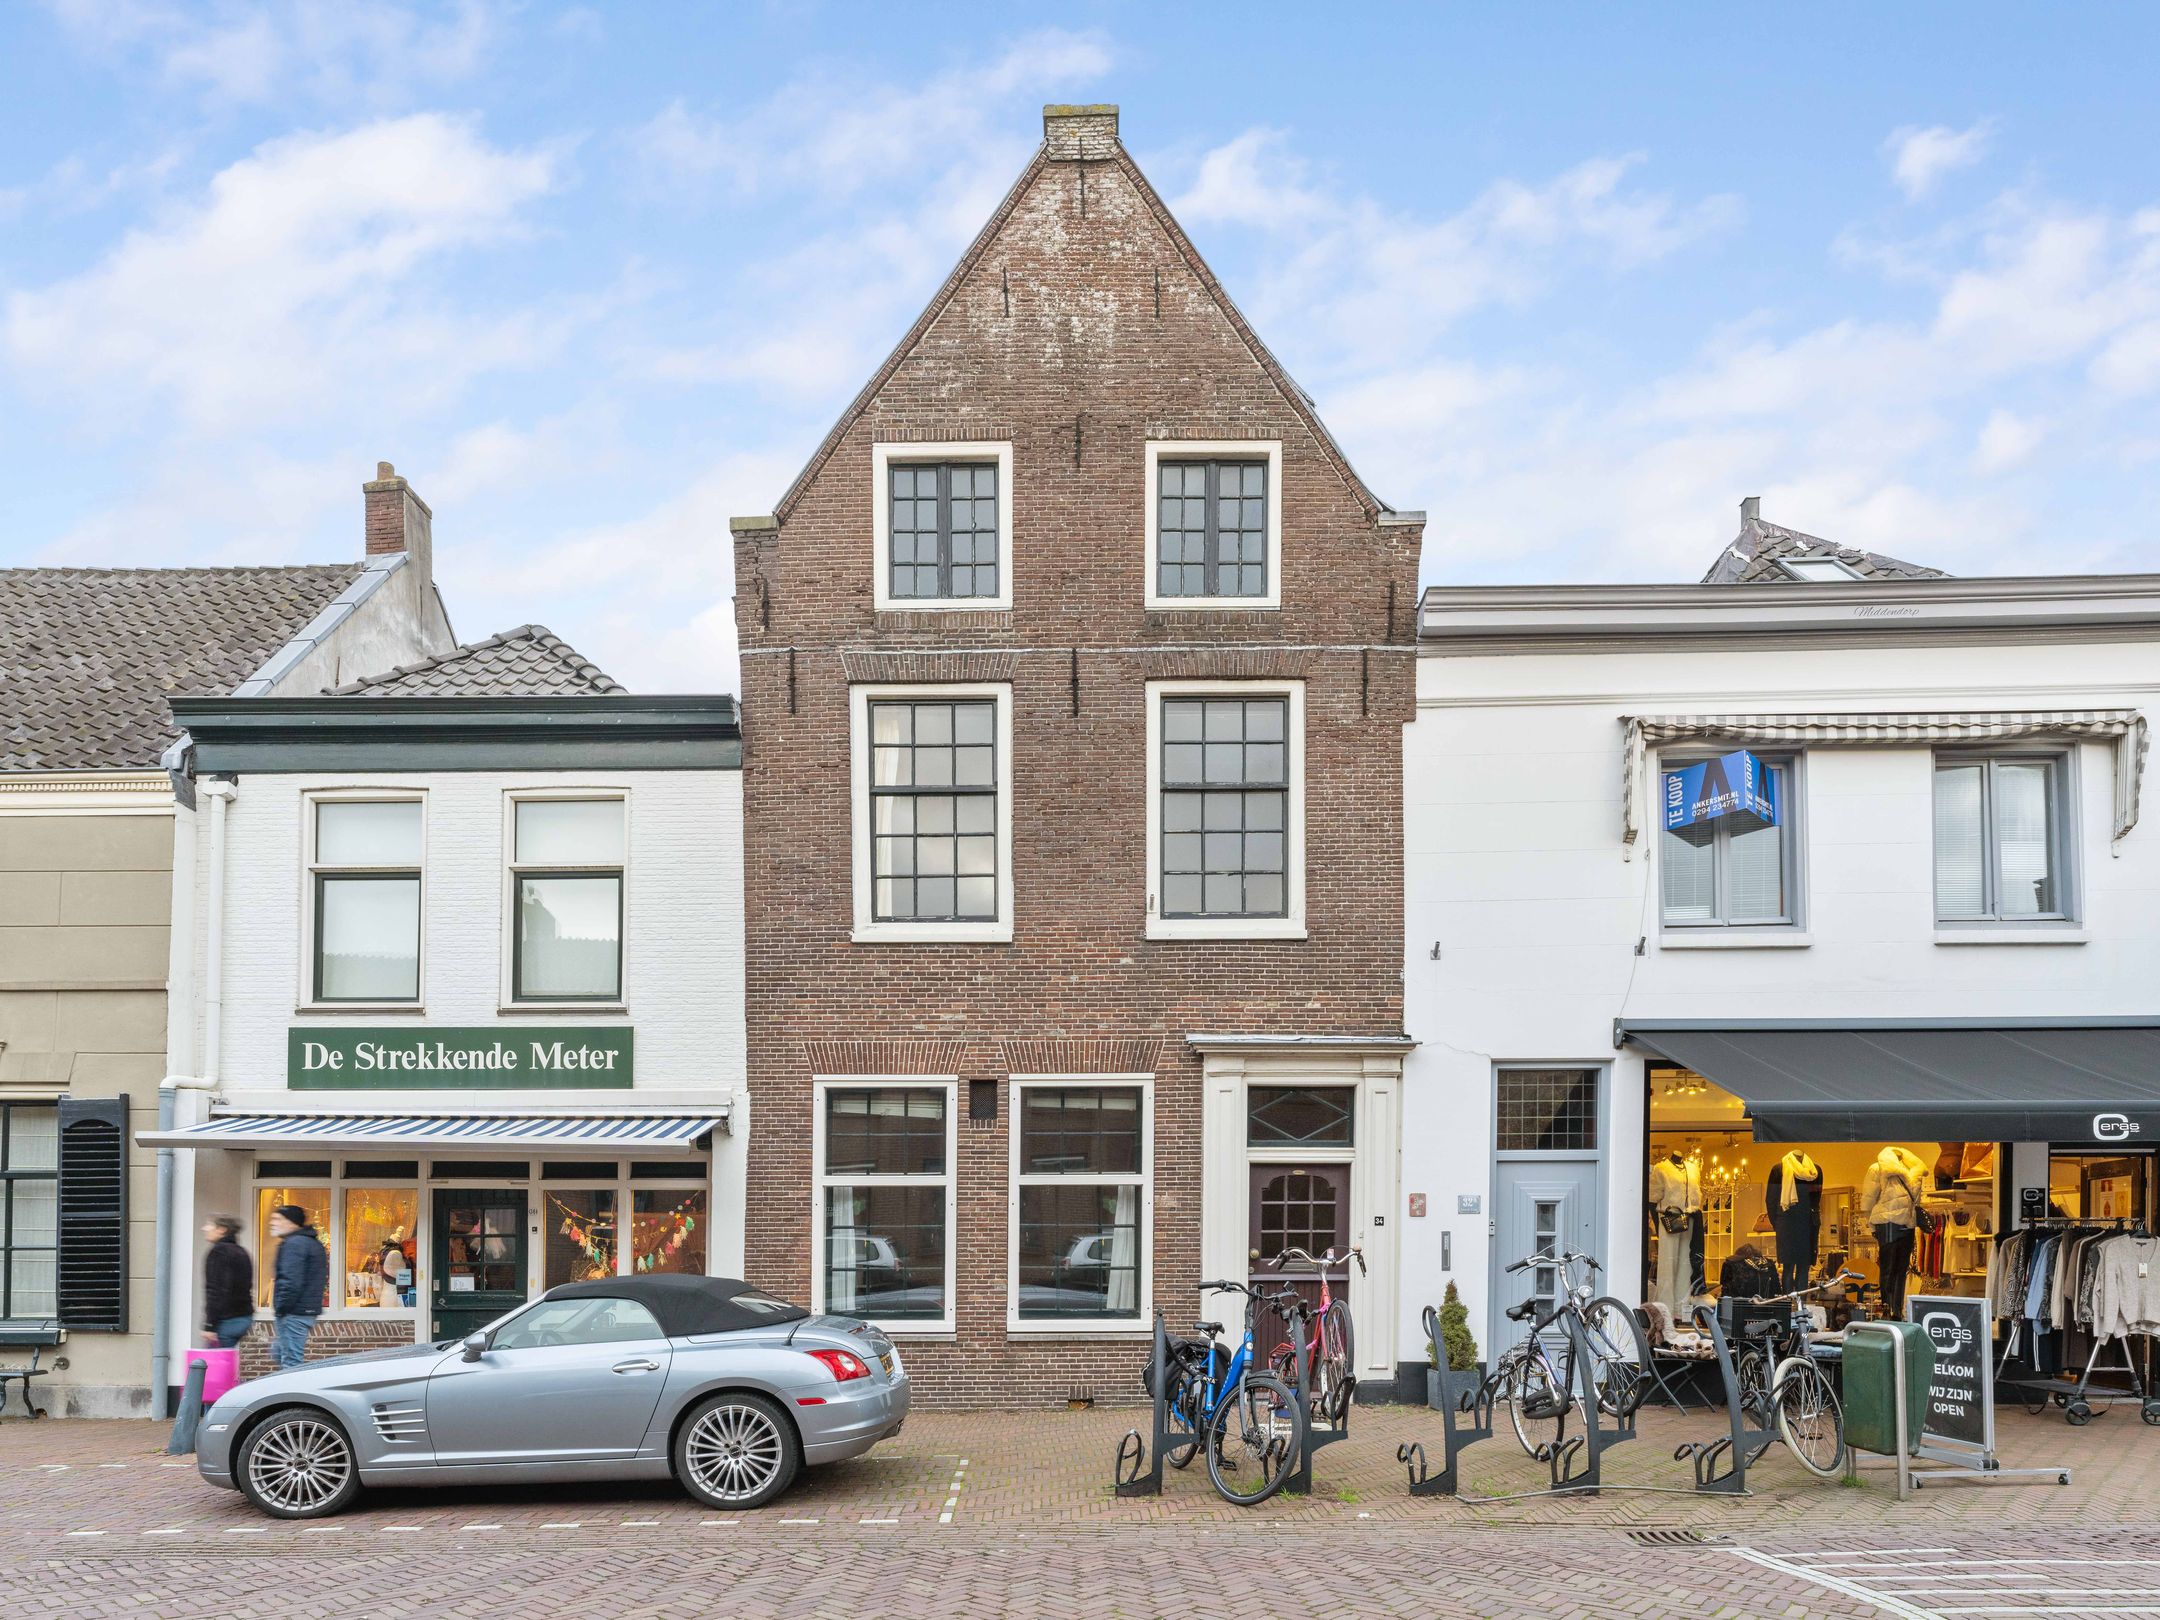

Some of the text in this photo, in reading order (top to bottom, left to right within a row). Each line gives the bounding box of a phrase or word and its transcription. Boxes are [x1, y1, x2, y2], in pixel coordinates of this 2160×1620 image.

[1853, 606, 1920, 617] Middendorp
[1668, 775, 1683, 826] TE KOOP
[1691, 790, 1740, 810] ANKERSMIT.NL
[1691, 805, 1711, 817] 0294
[302, 1042, 619, 1071] De Strekkende Meter
[1375, 1217, 1384, 1225] 34
[1933, 1363, 1974, 1378] ELKOM
[1946, 1387, 1973, 1402] ZIJN
[1933, 1401, 1965, 1417] OPEN
